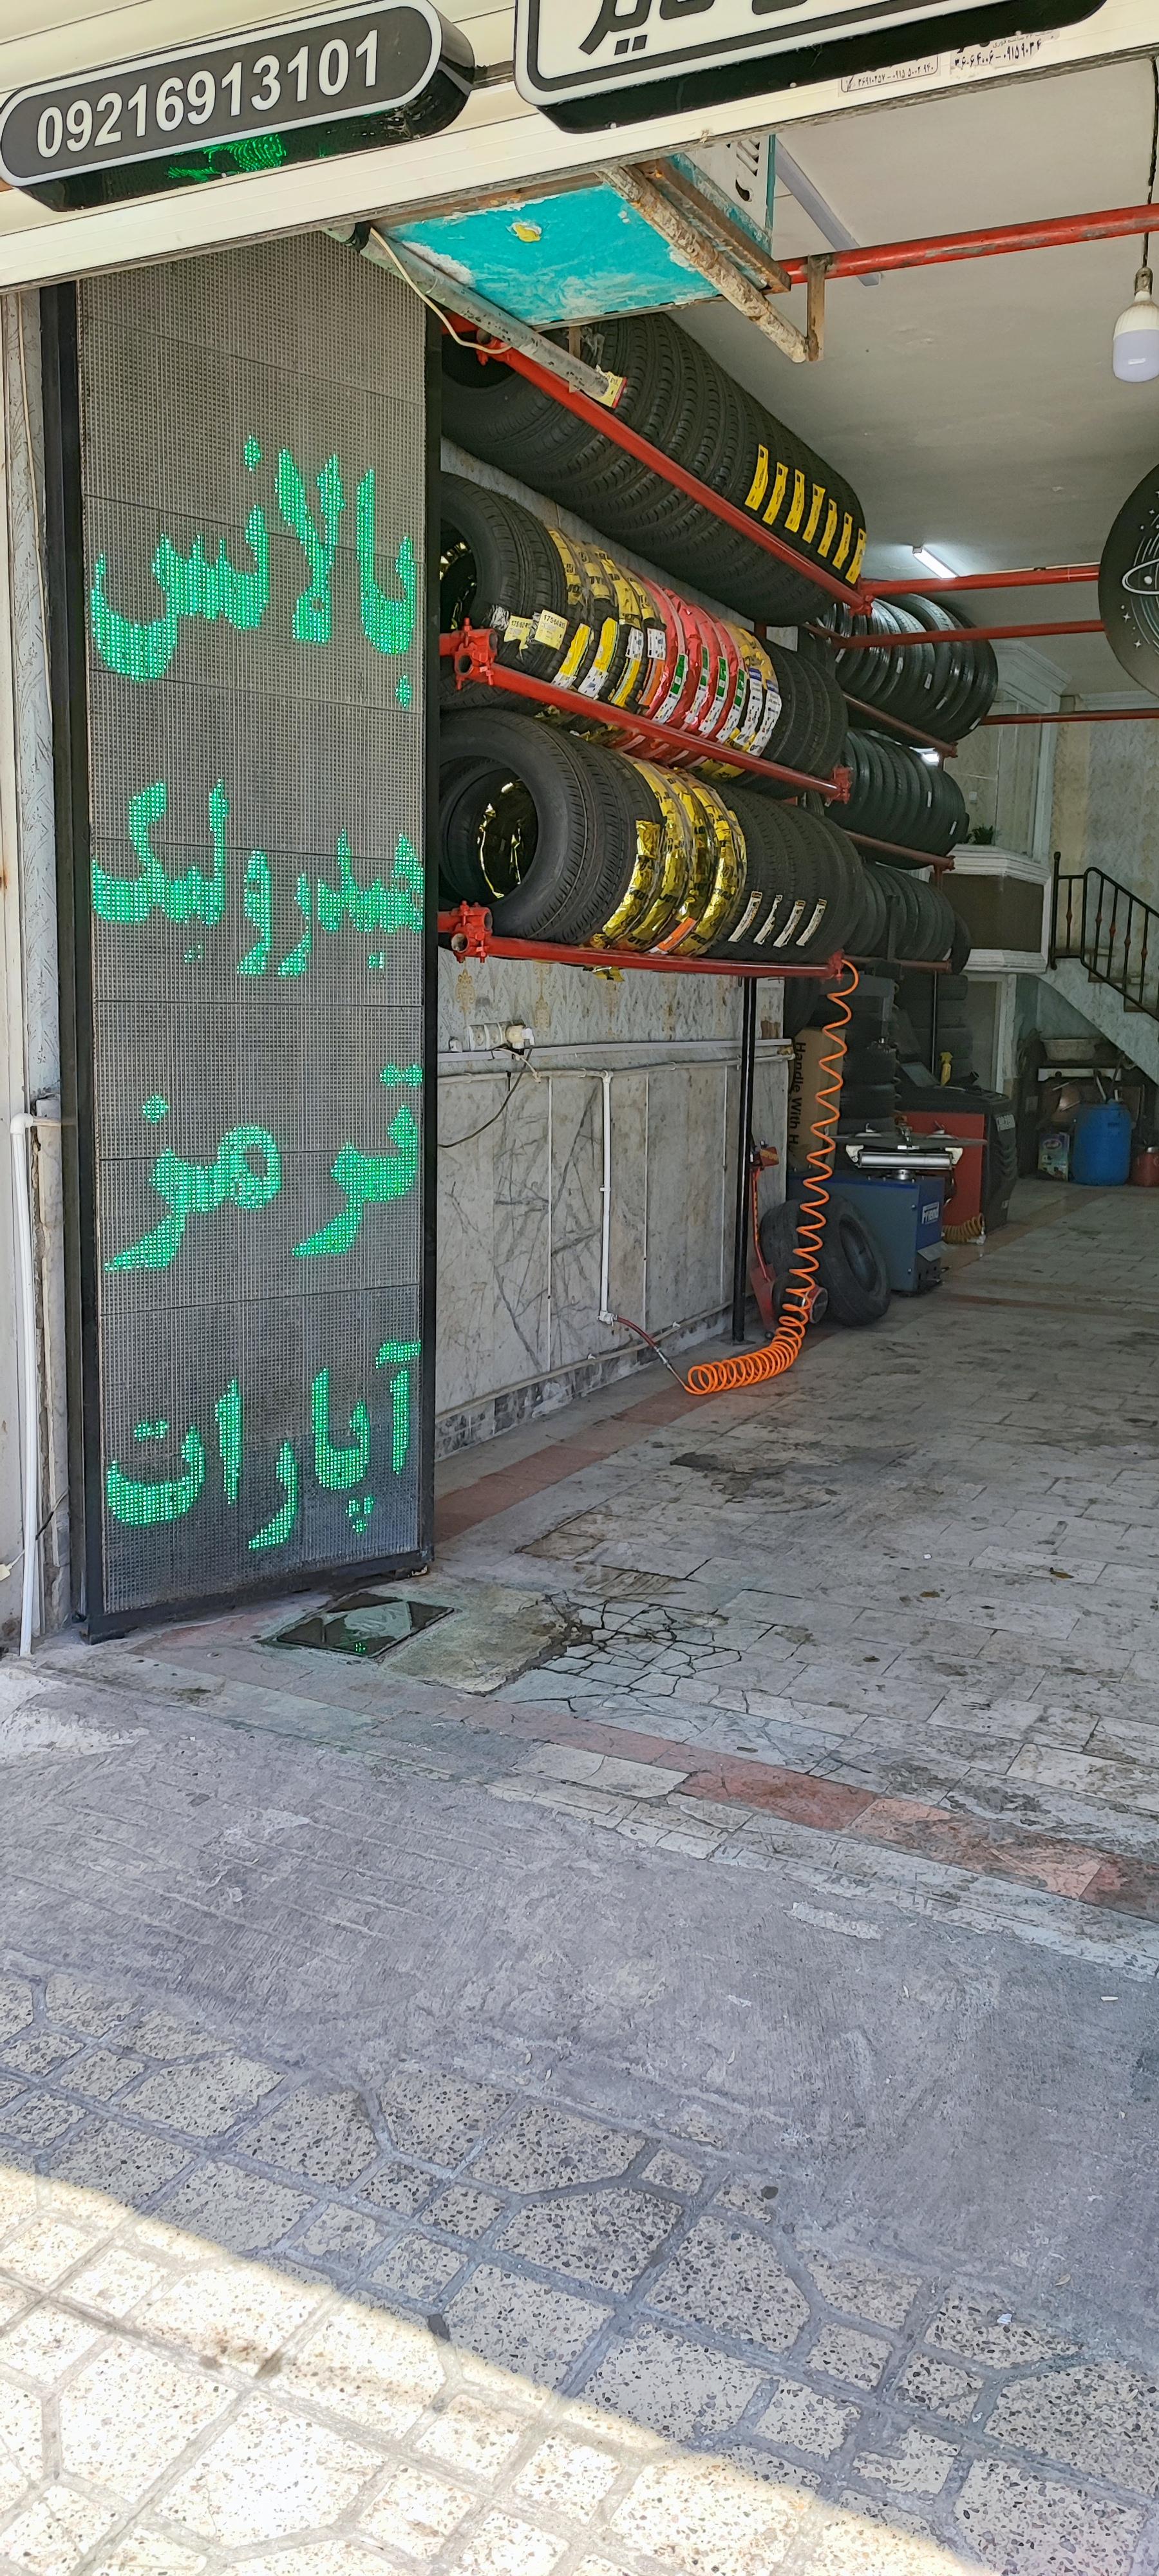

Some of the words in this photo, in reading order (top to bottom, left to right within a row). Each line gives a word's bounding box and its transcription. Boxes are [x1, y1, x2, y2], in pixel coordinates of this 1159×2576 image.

[37, 30, 379, 158] 09216913101
[91, 434, 417, 708] بالانس
[92, 778, 424, 977] هیدرولیک
[104, 1063, 422, 1271] ترمز
[789, 1097, 802, 1130] With
[793, 1042, 807, 1093] Handle
[106, 1340, 420, 1549] آپارات
